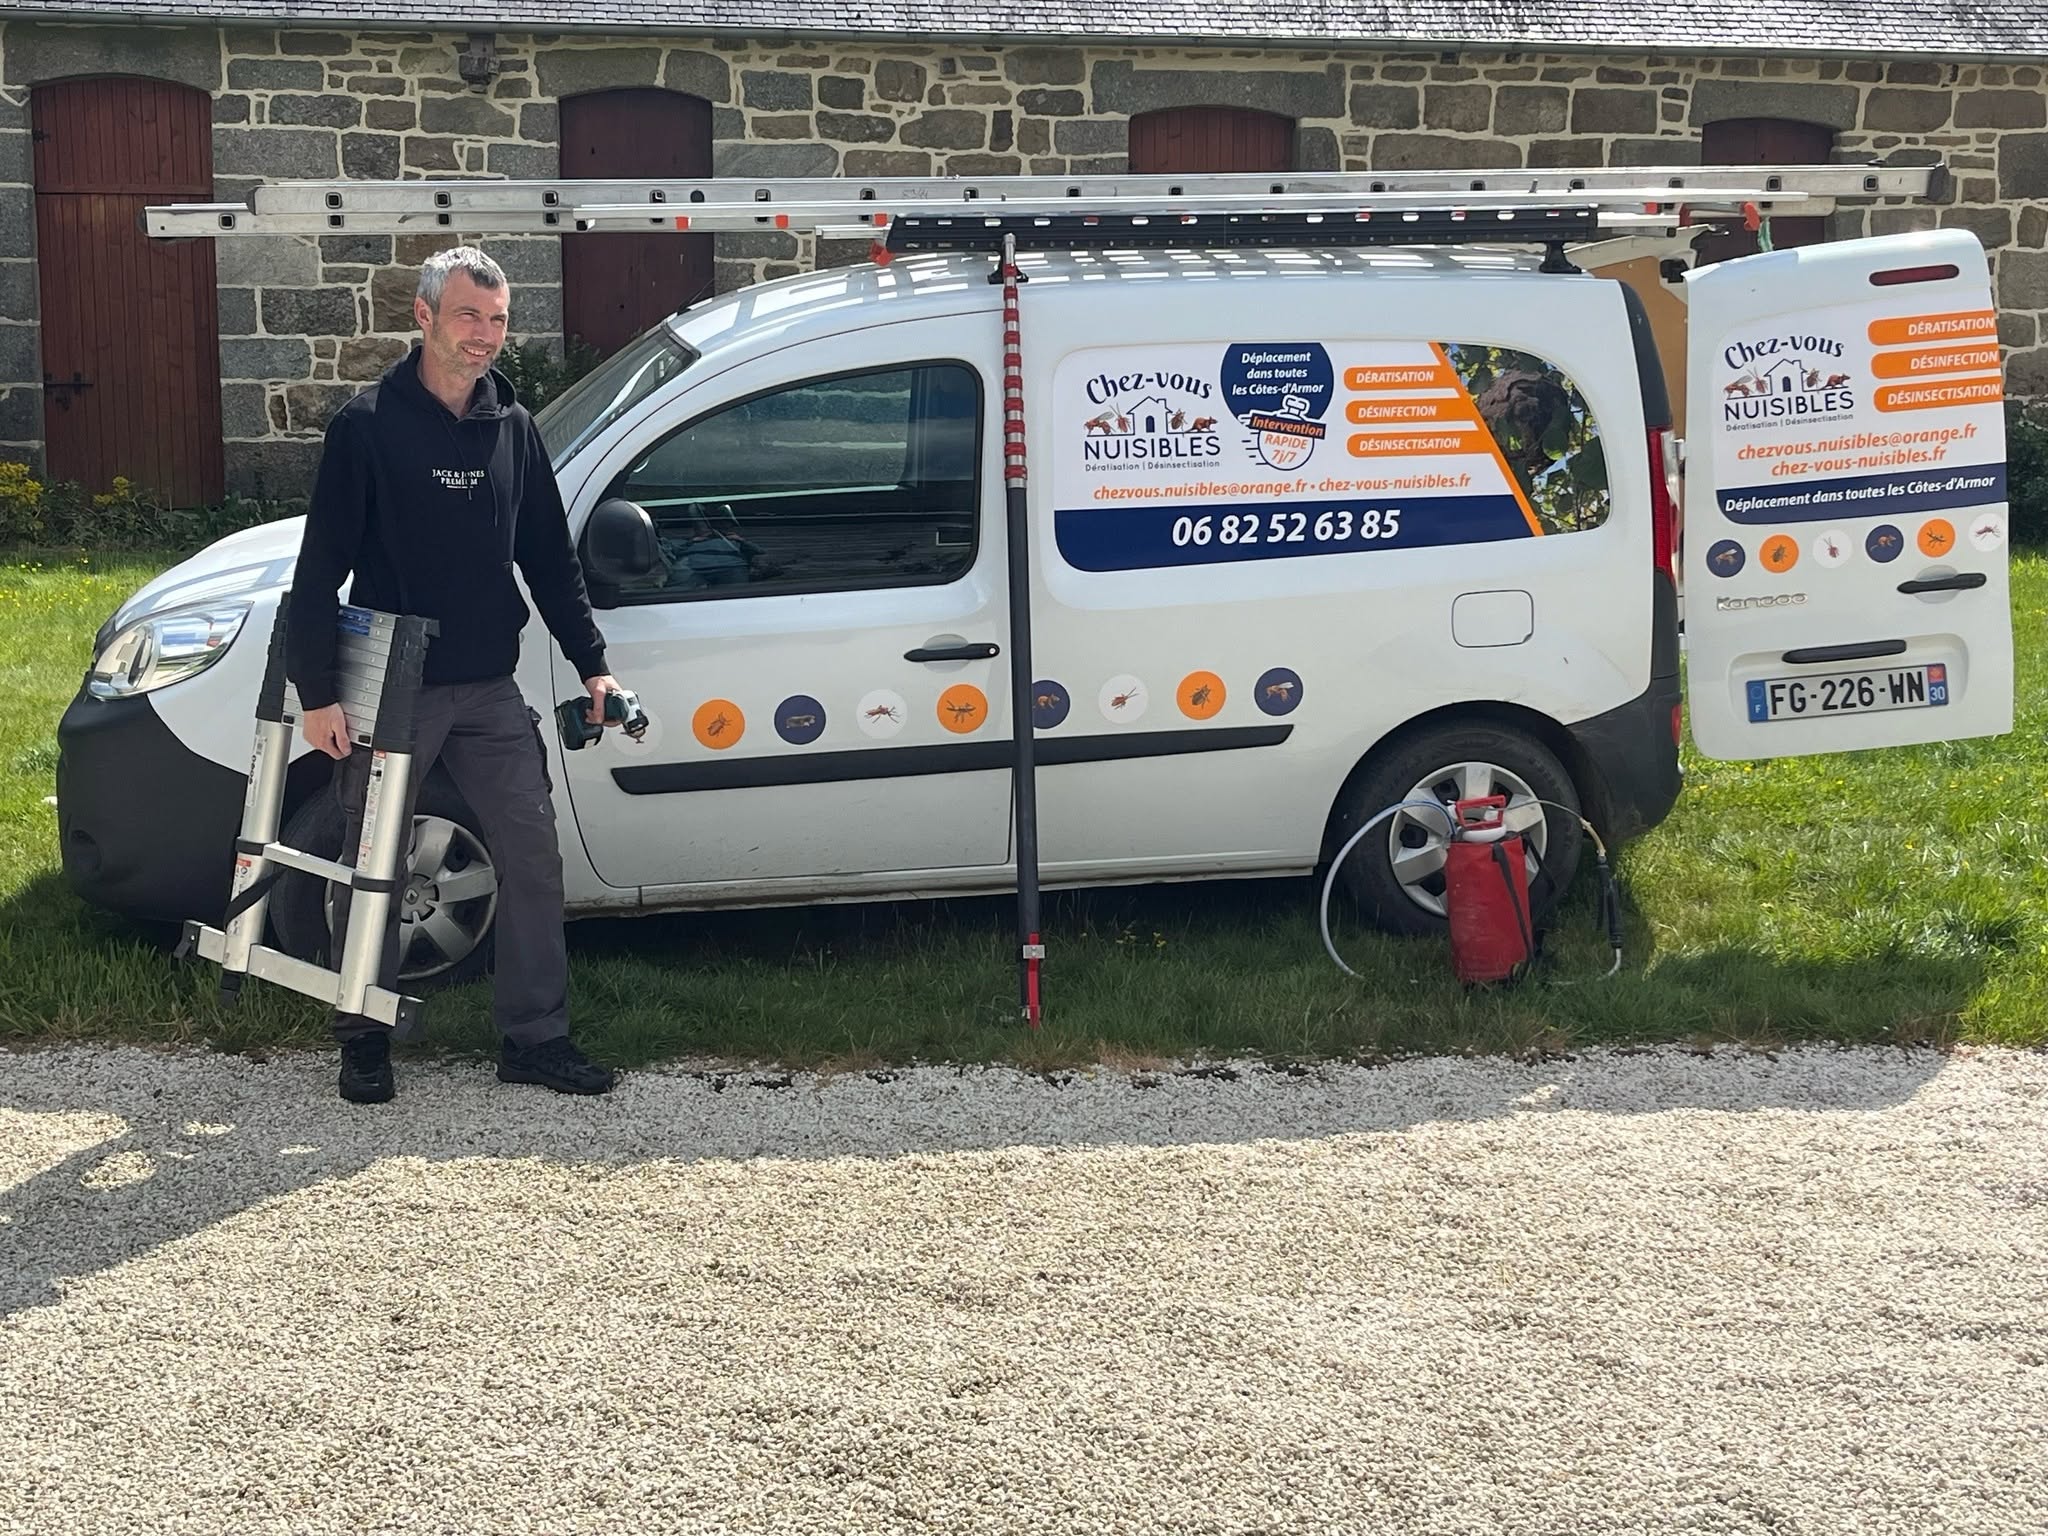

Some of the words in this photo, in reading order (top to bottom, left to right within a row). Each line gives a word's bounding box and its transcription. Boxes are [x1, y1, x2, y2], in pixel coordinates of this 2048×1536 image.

[1908, 317, 1995, 336] DÉRATISATION
[1241, 351, 1311, 365] Déplacement
[1724, 335, 1845, 370] Chez-vous
[1910, 350, 1998, 370] DÉSINFECTION
[1246, 367, 1273, 379] dans
[1274, 367, 1308, 378] toutes
[1356, 370, 1434, 384] DÉRATISATION
[1086, 371, 1212, 404] Chez-vous
[1232, 383, 1248, 396] les
[1248, 381, 1324, 395] Côtes-d'Armor
[1887, 384, 2000, 406] DÉSINSECTISATION
[1358, 403, 1437, 419] DÉSINFECTION
[1725, 391, 1854, 422] NUISIBLES
[1252, 416, 1324, 437] Intervention
[1726, 420, 1778, 432] Dératisation
[1785, 413, 1854, 427] Désinsectisation
[1084, 435, 1221, 461] NUISIBLES
[1264, 433, 1308, 450] RAPIDE
[1359, 436, 1461, 451] DÉSINSECTISATION
[1737, 423, 1978, 461] chezvous.nuisibles@orange.fr
[1085, 461, 1140, 472] Dératisation
[1147, 459, 1220, 471] Désinsectisation
[1271, 449, 1297, 464] 7j/7
[1771, 446, 1946, 476] chez-vous-nuisibles.fr
[432, 469, 452, 478] JACK
[1093, 479, 1308, 500] chezvous.nuisibles@orange.fr
[1318, 473, 1471, 492] chez-vous-nuisibles.fr
[1725, 492, 1811, 513] Déplacement
[1812, 489, 1844, 505] dans
[1846, 485, 1885, 500] toutes
[1887, 482, 1905, 496] les
[1907, 475, 1995, 495] Côtes-d'Armor
[1172, 515, 1212, 546] 06
[1219, 514, 1258, 543] 82
[1266, 512, 1306, 542] 52
[1313, 510, 1353, 540] 63
[1360, 508, 1400, 539] 85
[1755, 704, 1761, 714] F
[1770, 671, 1925, 715] FG-226-WN
[1930, 685, 1946, 701] 30
